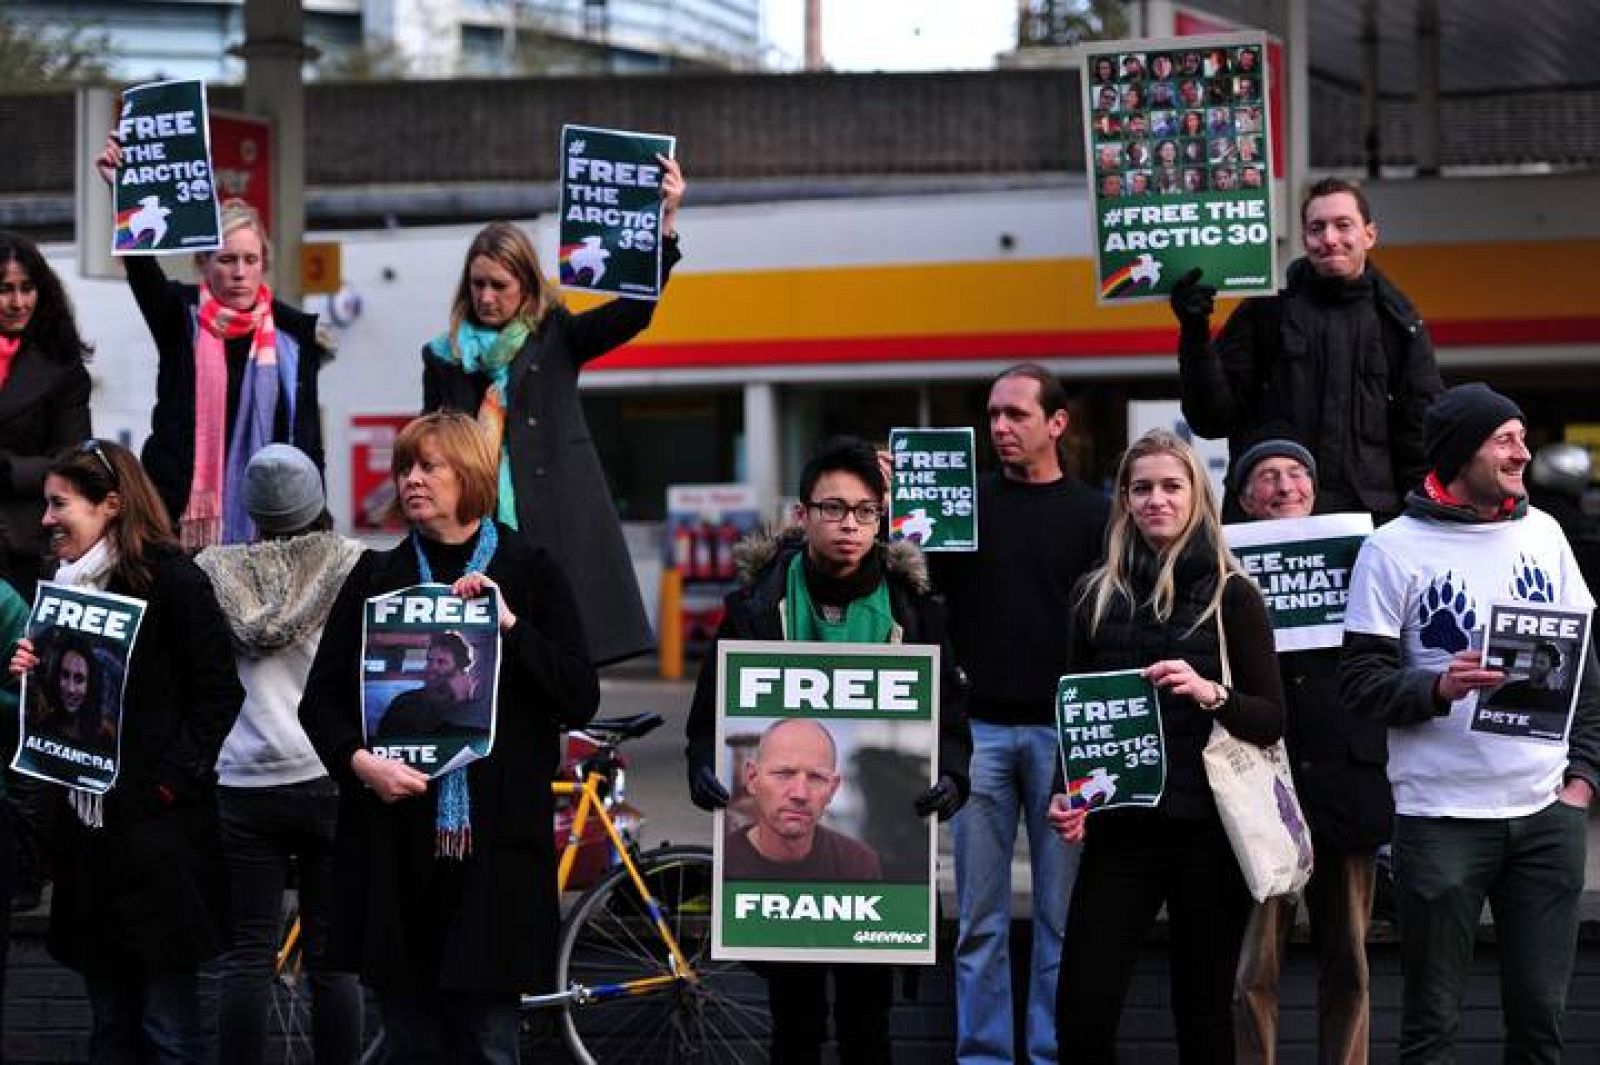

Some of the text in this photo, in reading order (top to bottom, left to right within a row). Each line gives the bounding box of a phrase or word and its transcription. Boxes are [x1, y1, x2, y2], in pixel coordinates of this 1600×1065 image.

[119, 111, 196, 141] FREE
[121, 142, 166, 163] THE
[568, 140, 585, 156] #
[122, 160, 207, 186] ARCTIC
[568, 157, 660, 188] FREE
[568, 184, 620, 206] THE
[566, 204, 658, 230] ARCTIC
[1103, 200, 1265, 227] #FREE THE
[1105, 225, 1268, 251] ARCTIC 30
[895, 451, 967, 469] FREE
[895, 471, 937, 485] THE
[895, 486, 972, 500] ARCTIC
[1242, 551, 1325, 573] EE THE
[1250, 567, 1347, 595] LIMAT
[37, 596, 131, 640] FREE
[372, 596, 491, 624] FREE
[1494, 612, 1580, 639] FREE
[739, 667, 919, 711] FREE
[1062, 686, 1079, 702] #
[1063, 696, 1150, 724] FREE
[1065, 724, 1115, 743] THE
[1068, 733, 1159, 760] ARCTIC
[735, 893, 883, 921] FRANK
